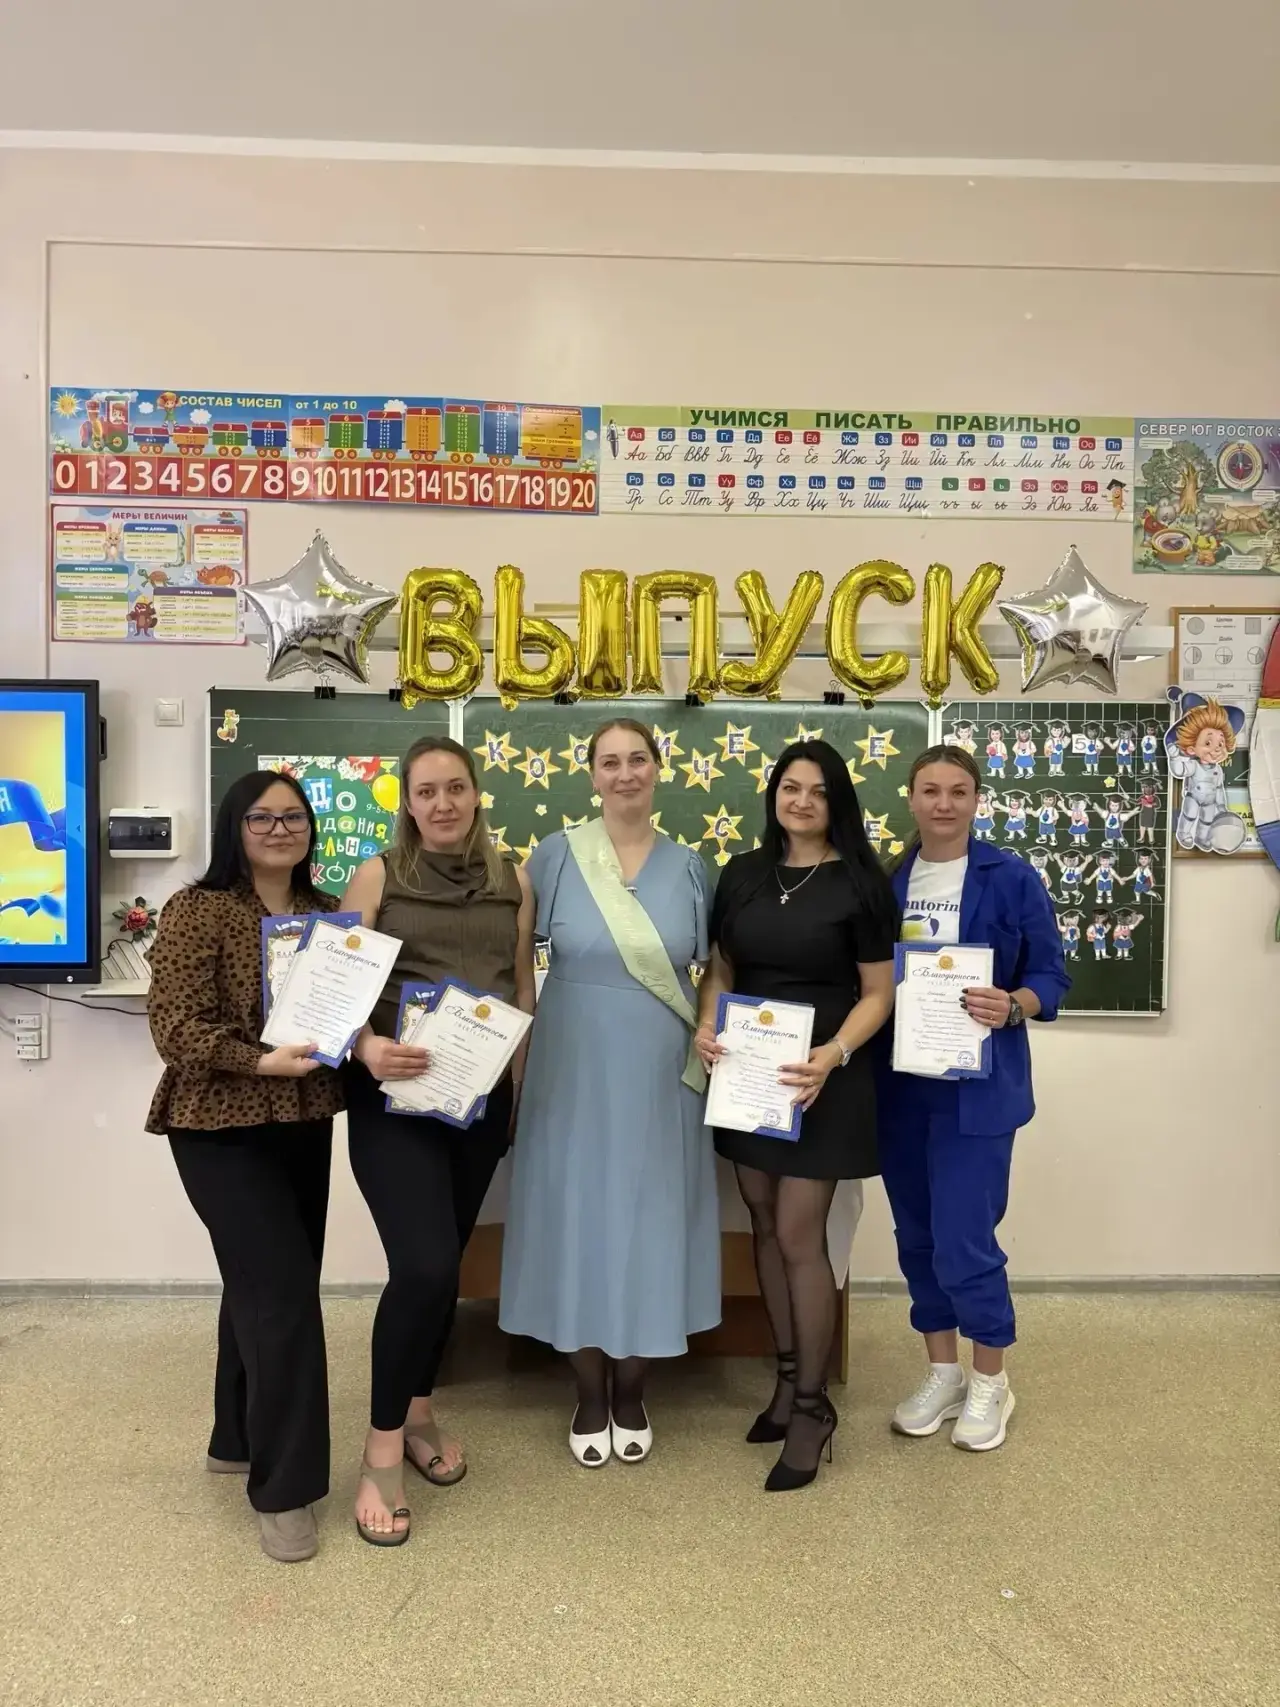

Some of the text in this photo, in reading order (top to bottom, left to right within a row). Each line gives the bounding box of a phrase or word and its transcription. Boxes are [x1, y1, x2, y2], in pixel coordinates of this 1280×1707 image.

[180, 396, 233, 407] СОСТАВ
[237, 398, 282, 408] ЧИСЕЛ
[313, 401, 319, 409] 1
[322, 401, 338, 411] до
[342, 401, 357, 410] 10
[690, 410, 1081, 433] УЧИМСЯ ПИСАТЬ ПРАВИЛЬНО
[1139, 424, 1274, 436] СЕВЕР ЮГ ВОСТОК
[630, 430, 1120, 448] Аа Бб Вв Гг Дд Ее Ёё Жж Зз Ии Йй Кк Лл Мм Нн Оо Пп
[56, 461, 595, 508] 0 1 2 3 4 5 6 7 8 9 10 11 12 13 14 15 16 17 18 19 20
[629, 476, 641, 485] Рр
[661, 476, 672, 484] Сс
[721, 477, 732, 486] Уу
[747, 478, 763, 488] Фф
[781, 478, 793, 486] Хх
[811, 478, 824, 488] Цц
[840, 479, 852, 487] Чч
[400, 558, 1004, 706] ВЫПУСК
[316, 815, 389, 844] дания,
[310, 862, 356, 885] КОЛ
[315, 939, 380, 970] Благодарность
[912, 966, 980, 982] Благодарность
[444, 1004, 508, 1041] Благодарность
[732, 1018, 798, 1040] Благодарность
